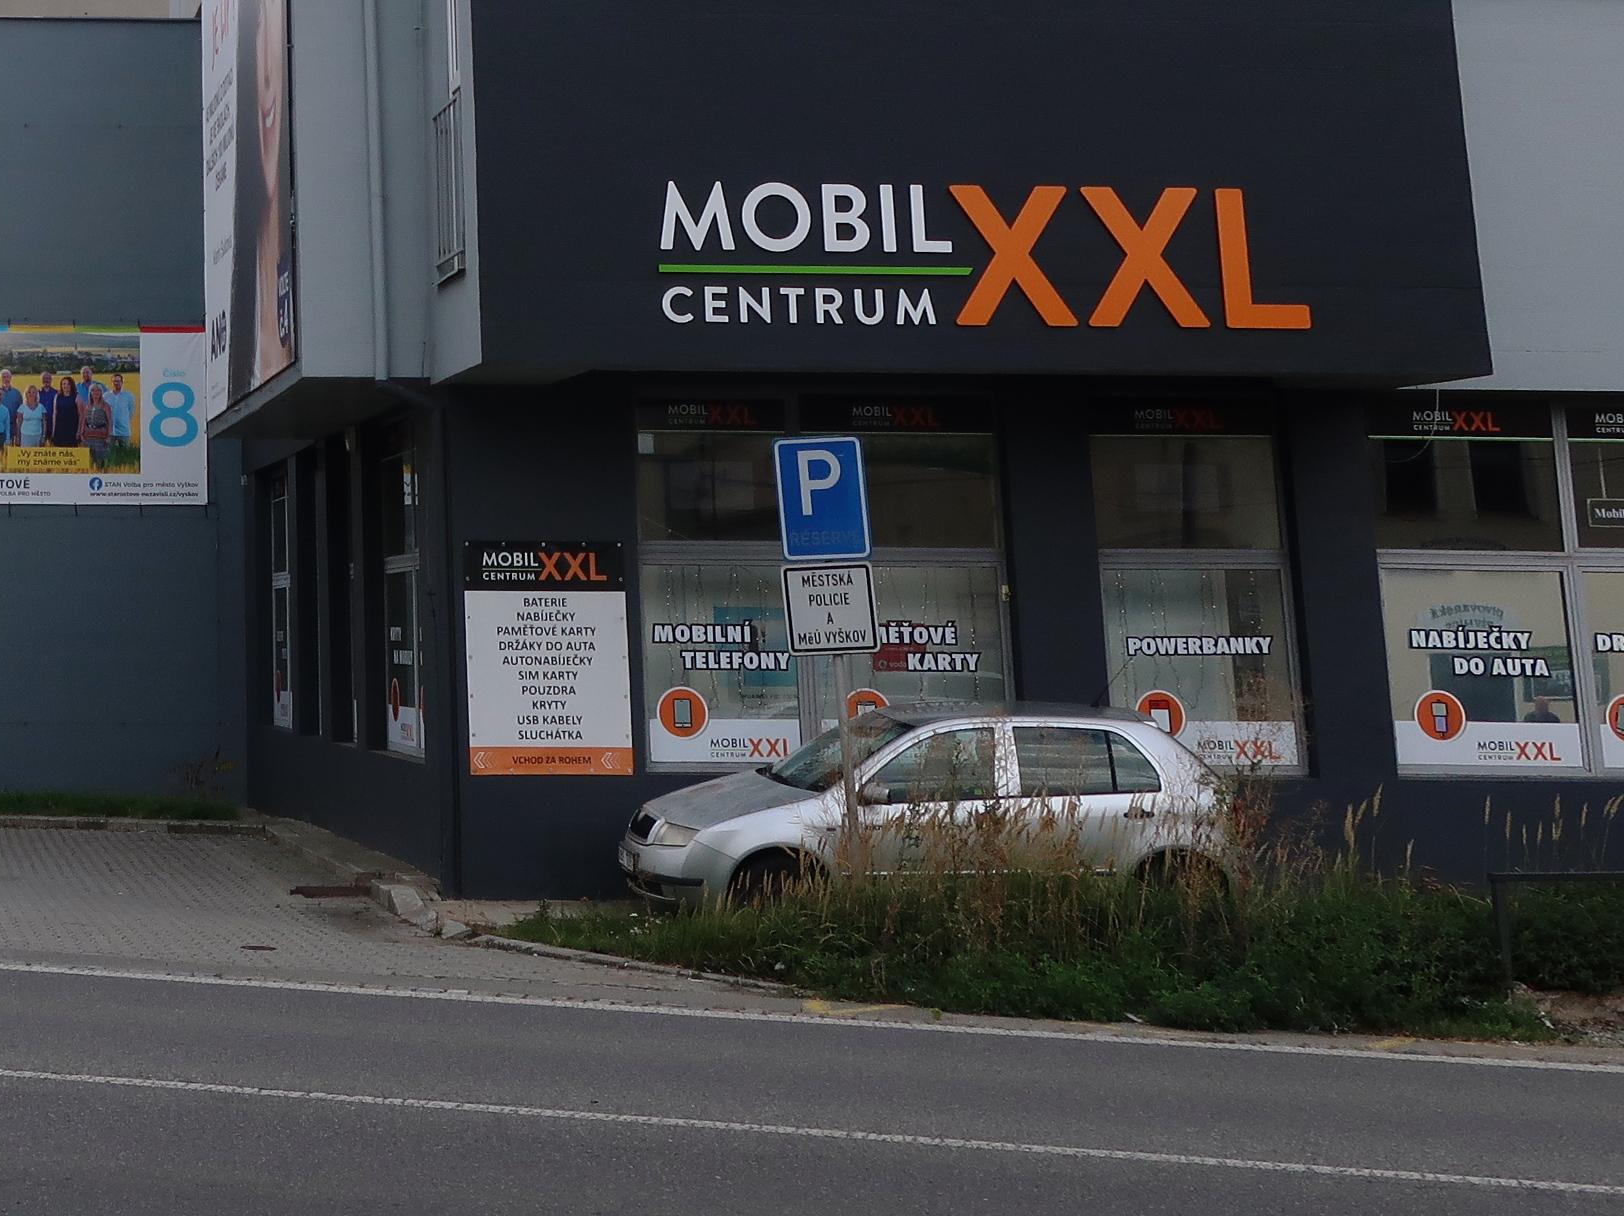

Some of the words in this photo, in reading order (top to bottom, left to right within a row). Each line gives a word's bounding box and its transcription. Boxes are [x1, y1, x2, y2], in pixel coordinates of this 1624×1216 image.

[660, 180, 953, 253] MOBIL
[948, 184, 1312, 329] XXL
[662, 287, 937, 325] CENTRUM
[149, 382, 199, 447] 8
[668, 404, 708, 416] MOBIL
[851, 405, 891, 417] MOBIL
[1412, 411, 1452, 422] MOBIL
[1452, 411, 1501, 432] XXL
[797, 449, 841, 516] P
[482, 551, 538, 567] MOBIL
[538, 552, 608, 581] XXL
[482, 572, 535, 581] CENTRUM
[802, 570, 853, 587] MĚSTSKÁ
[523, 598, 568, 608] BATERIE
[809, 592, 850, 607] POLICIE
[517, 611, 576, 622] NABÍJEČKY
[827, 612, 834, 624] A
[496, 625, 558, 636] PAMĚŤOVÉ
[561, 626, 596, 636] KARTY
[653, 621, 752, 643] MOBILNÍ
[824, 627, 867, 644] VYŠKOV
[1410, 625, 1533, 650] NABÍJEČKY
[499, 639, 542, 651] DRŽÁKY
[546, 641, 563, 651] DO
[566, 641, 596, 651] AUTA
[1126, 636, 1273, 656] POWERBANKY
[502, 654, 593, 666] AUTONABÍJEČKY
[681, 651, 791, 671] TELEFONY
[907, 652, 981, 672] KARTY
[1453, 657, 1485, 676] DO
[1491, 657, 1551, 677] AUTA
[518, 671, 539, 680] SIM
[543, 671, 578, 680] KARTY
[522, 686, 576, 695] POUZDRA
[532, 701, 567, 710] KRYTY
[517, 715, 539, 725] USB
[542, 715, 583, 725] KABELY
[518, 728, 583, 740] SLUCHÁTKA
[710, 738, 748, 748] MOBIL
[1197, 739, 1234, 750] MOBIL
[1477, 741, 1514, 751] MOBIL
[1514, 741, 1562, 762] XXL
[512, 756, 543, 764] VCHOD
[545, 756, 557, 764] ZA
[558, 756, 592, 764] ROHEM
